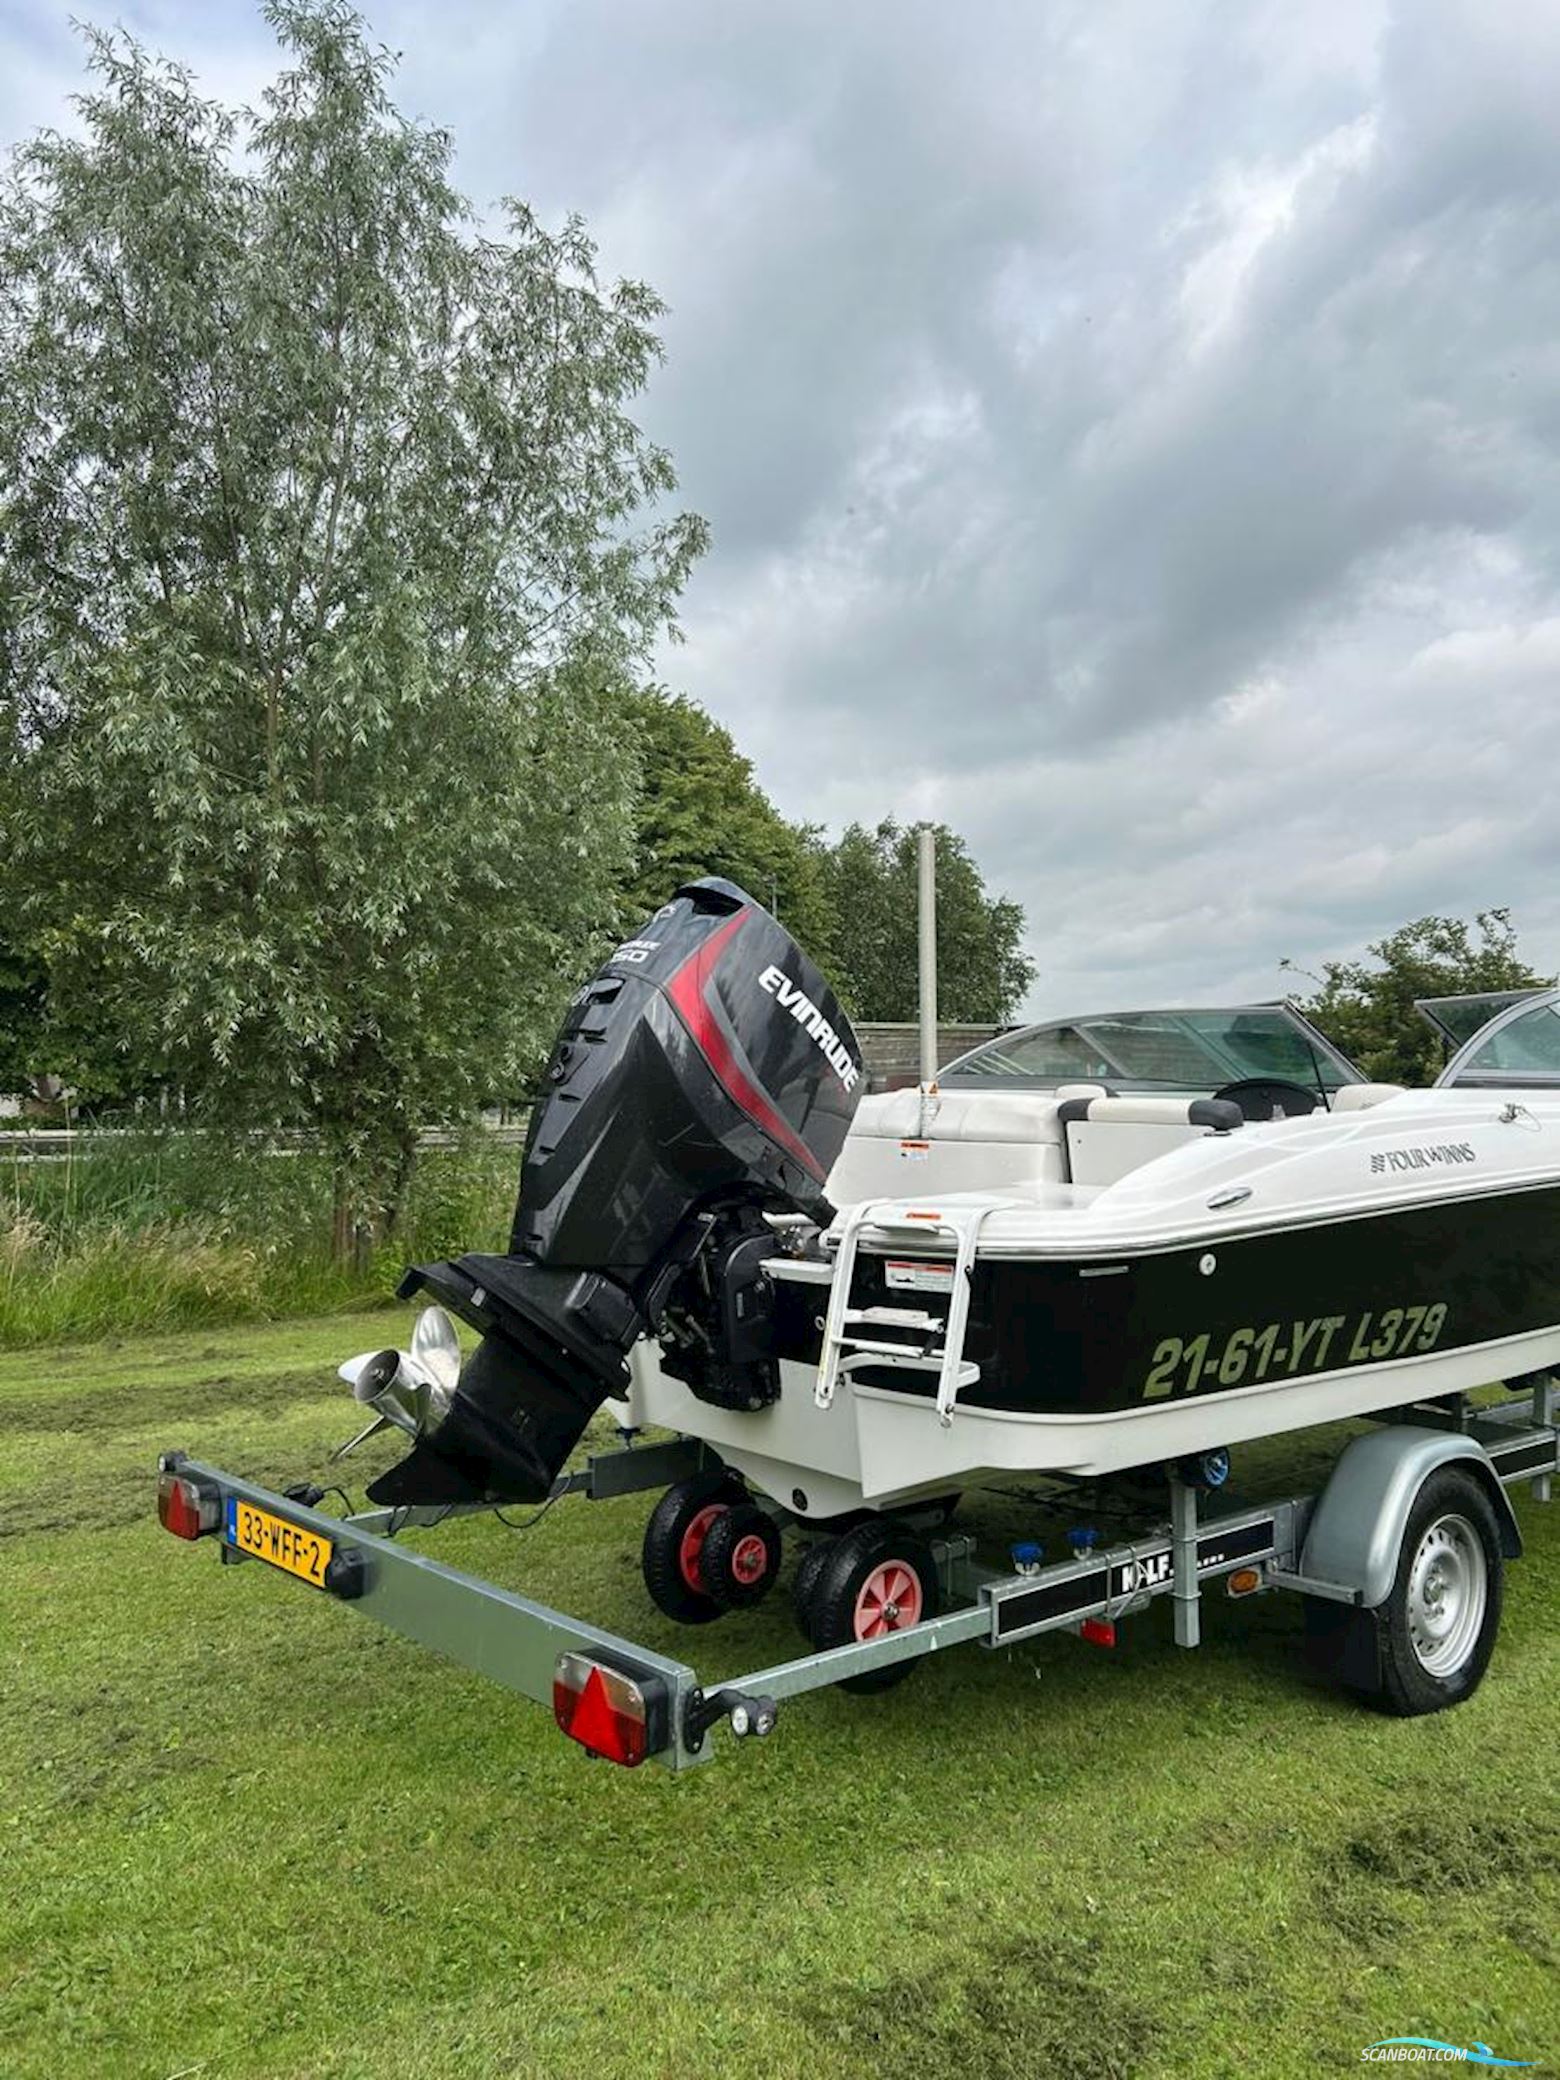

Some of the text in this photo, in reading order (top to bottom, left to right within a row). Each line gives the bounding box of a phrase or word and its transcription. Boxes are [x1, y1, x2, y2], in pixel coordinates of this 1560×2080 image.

[758, 964, 860, 1093] EVINRUDE
[1385, 1142, 1477, 1172] FOUR WINNS
[1142, 1302, 1448, 1399] 21-61-YT L379
[243, 1511, 321, 1577] 33-WFF-2
